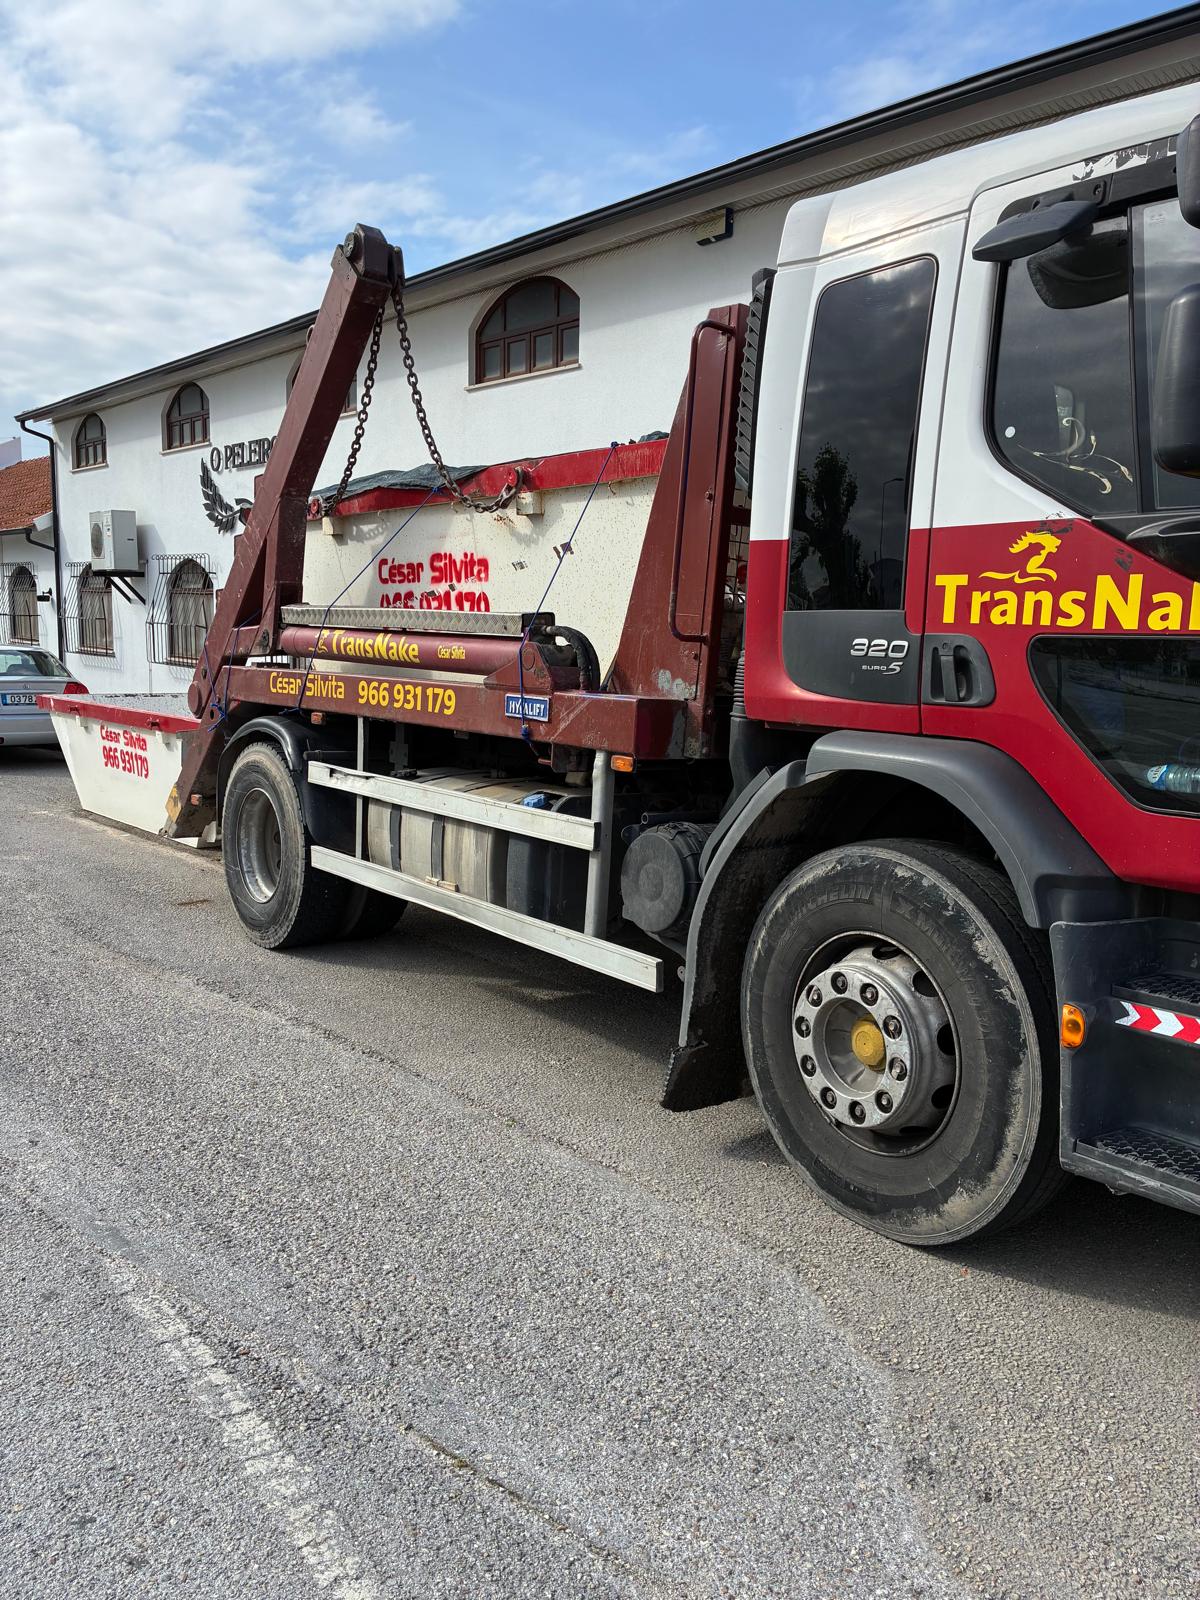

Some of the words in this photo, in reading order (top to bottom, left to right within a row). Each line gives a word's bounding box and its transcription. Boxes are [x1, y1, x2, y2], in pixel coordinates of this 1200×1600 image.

[210, 447, 221, 472] O
[378, 557, 424, 584] César
[429, 552, 489, 584] Silvita
[332, 629, 420, 664] TransNake
[850, 638, 909, 658] 320
[881, 661, 904, 675] 5
[10, 695, 33, 703] 0378
[269, 671, 301, 695] César
[305, 673, 345, 699] Silvita
[358, 680, 390, 708] 966
[393, 683, 422, 711] 931
[426, 687, 456, 715] 179
[100, 724, 121, 744] César
[102, 745, 119, 770] 966
